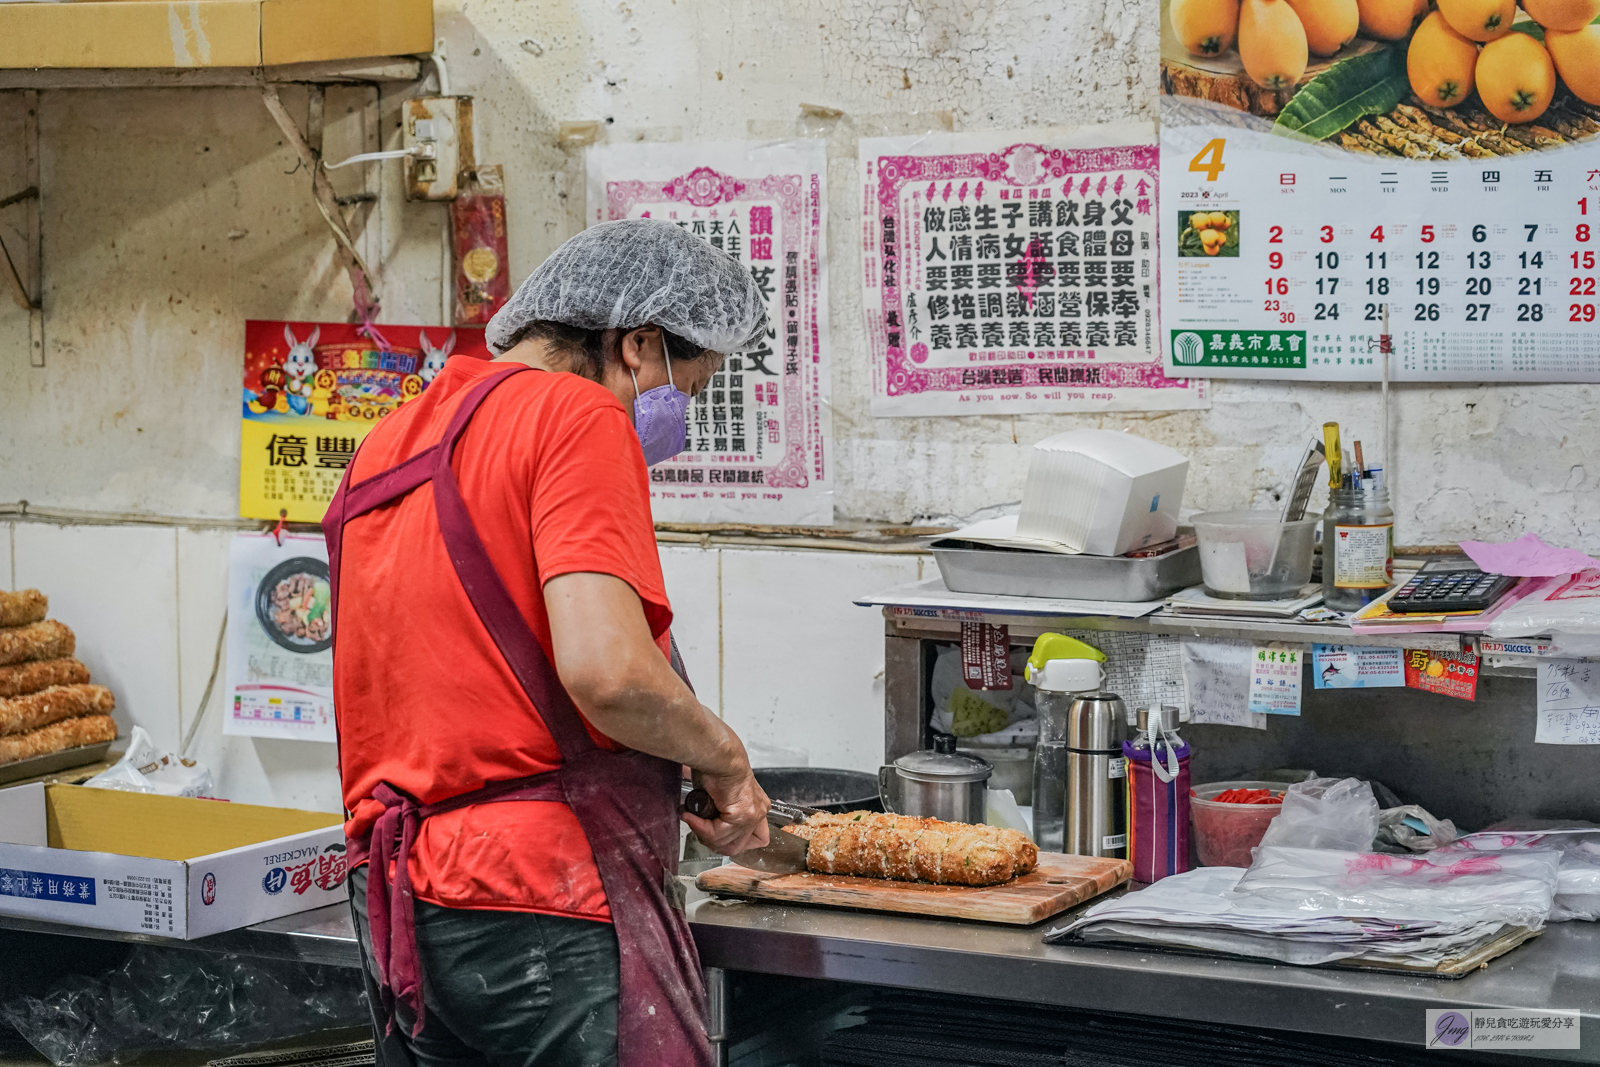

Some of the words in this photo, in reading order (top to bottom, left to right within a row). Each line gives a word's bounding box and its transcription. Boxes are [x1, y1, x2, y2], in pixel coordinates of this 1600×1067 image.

[1188, 138, 1226, 181] 4
[1280, 173, 1295, 185] 日
[1380, 172, 1398, 184] 二
[1430, 171, 1449, 183] 三
[1482, 171, 1500, 183] 四
[1534, 170, 1553, 183] 五
[1577, 197, 1587, 215] 1
[1269, 225, 1283, 243] 2
[1320, 225, 1334, 243] 3
[1370, 225, 1385, 243] 4
[1420, 225, 1435, 243] 5
[1472, 224, 1487, 243] 6
[1524, 224, 1538, 242] 7
[1575, 224, 1590, 242] 8
[1268, 251, 1283, 269] 9
[1315, 251, 1339, 269] 10
[1365, 251, 1386, 269] 11
[1415, 251, 1439, 269] 12
[1467, 251, 1491, 269] 13
[1519, 251, 1543, 269] 14
[1570, 251, 1595, 269] 15
[923, 207, 952, 349] 做人要修養
[949, 205, 978, 348] 感情要培養
[974, 204, 1004, 347] 生病要調養
[1001, 203, 1030, 347] 子女要教養
[1028, 200, 1056, 347] 講話要涵養
[1055, 201, 1083, 347] 飲食要營養
[1082, 200, 1110, 347] 身體要保養
[1110, 198, 1140, 347] 父母要奉養
[1265, 277, 1289, 295] 16
[1316, 277, 1339, 295] 17
[1366, 277, 1389, 295] 18
[1416, 277, 1440, 295] 19
[1465, 277, 1491, 295] 20
[1518, 277, 1541, 295] 21
[1569, 277, 1596, 295] 22
[1264, 300, 1280, 311] 23
[1314, 303, 1339, 320] 24
[1414, 303, 1440, 321] 26
[1465, 303, 1490, 321] 27
[1517, 303, 1543, 321] 28
[1569, 303, 1595, 321] 29
[1279, 312, 1295, 323] 30
[1209, 333, 1303, 351] 嘉義市農會
[962, 369, 1023, 385] 台灣製造
[959, 394, 971, 402] As
[976, 394, 994, 402] you
[1026, 392, 1037, 400] So
[1044, 391, 1062, 399] will
[1067, 392, 1085, 400] you
[1091, 391, 1117, 400] reap.
[266, 434, 355, 468] 億豐
[709, 469, 764, 484] 民間總統
[762, 492, 783, 501] reap
[1481, 642, 1504, 652] 成功
[1504, 644, 1532, 654] SUCCESS
[263, 845, 319, 866] MACKEREL
